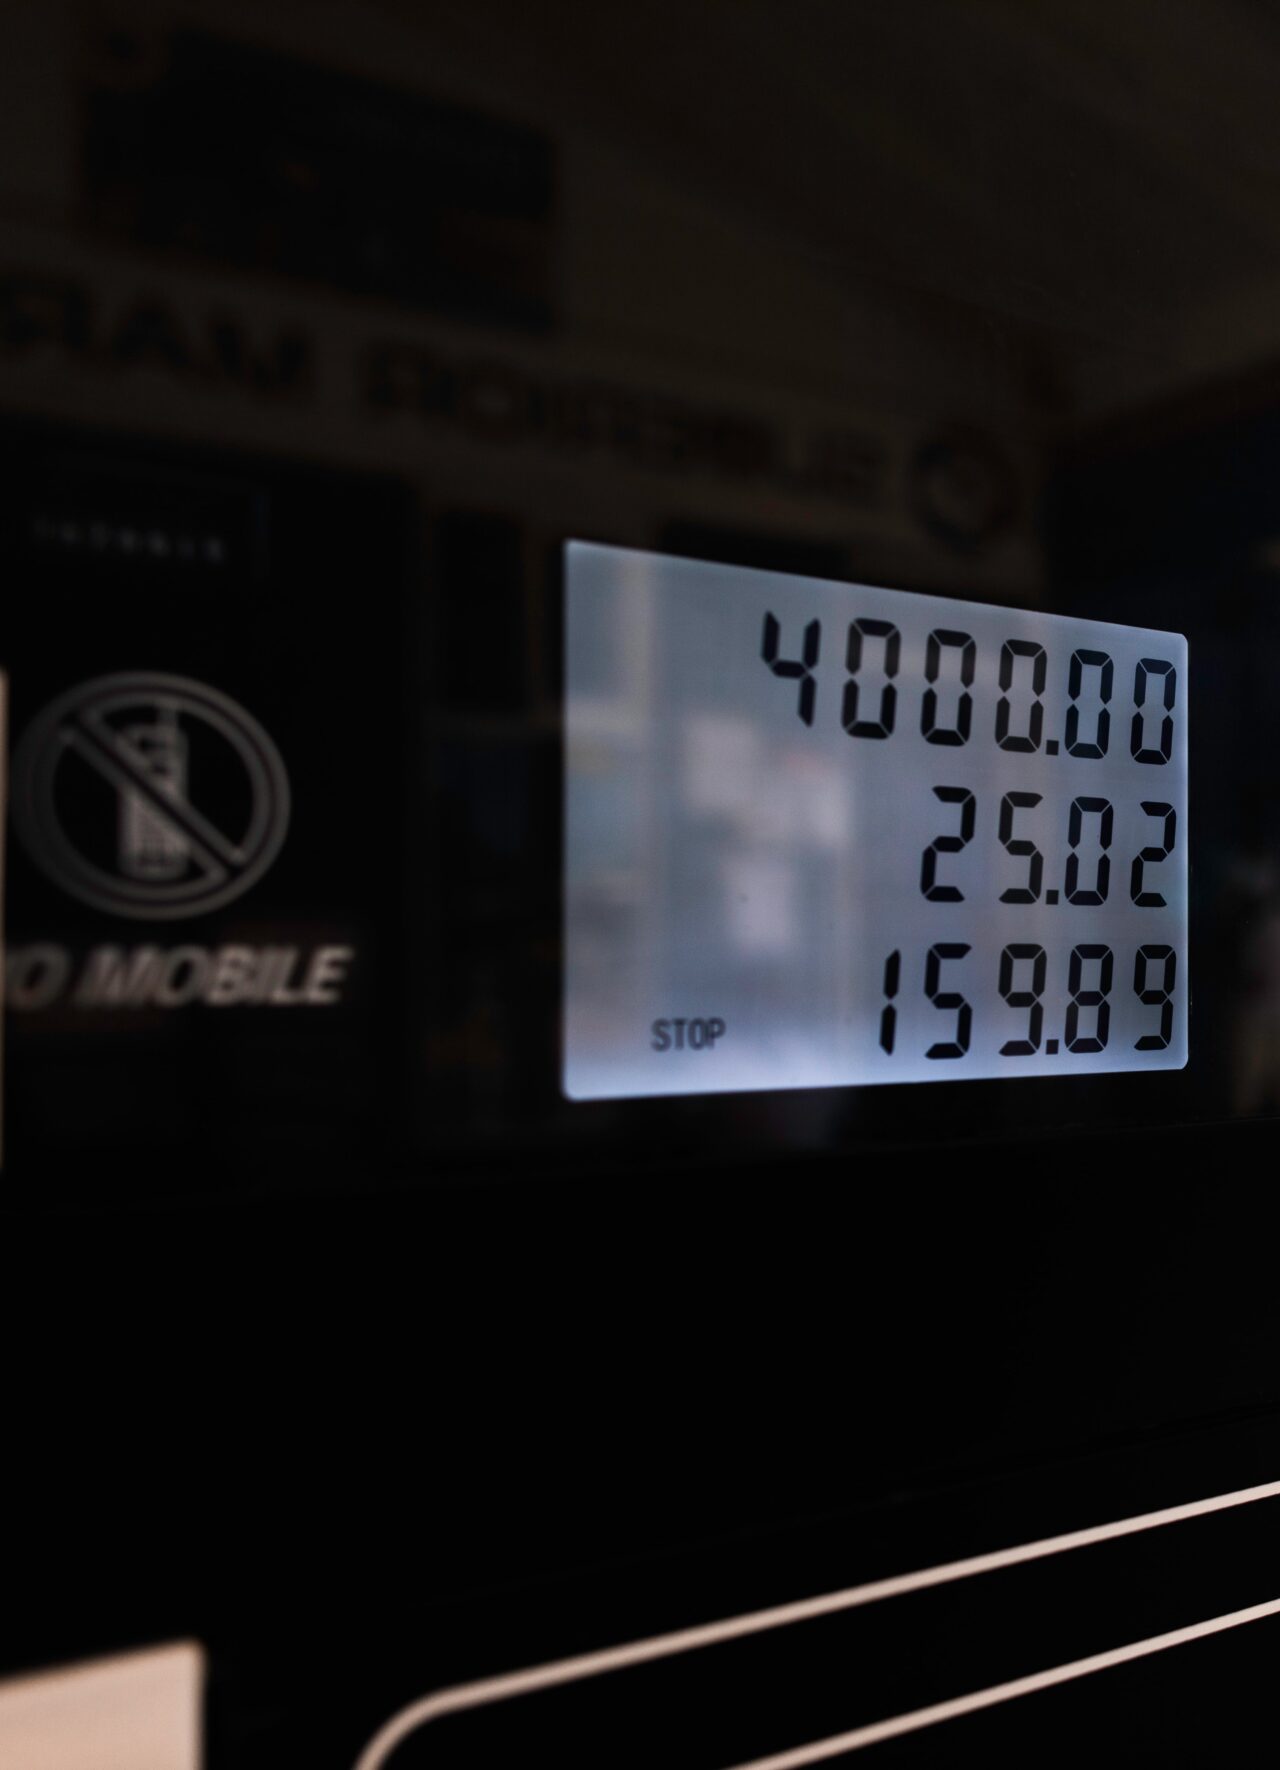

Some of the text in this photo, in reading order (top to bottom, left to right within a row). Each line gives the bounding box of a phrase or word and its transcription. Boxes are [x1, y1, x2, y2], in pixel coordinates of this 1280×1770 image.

[761, 611, 1177, 766] 4000.00
[920, 786, 1177, 907] 25.02
[72, 942, 356, 1010] MOBILE
[651, 1018, 725, 1051] STOP
[879, 943, 1177, 1060] 159.89
